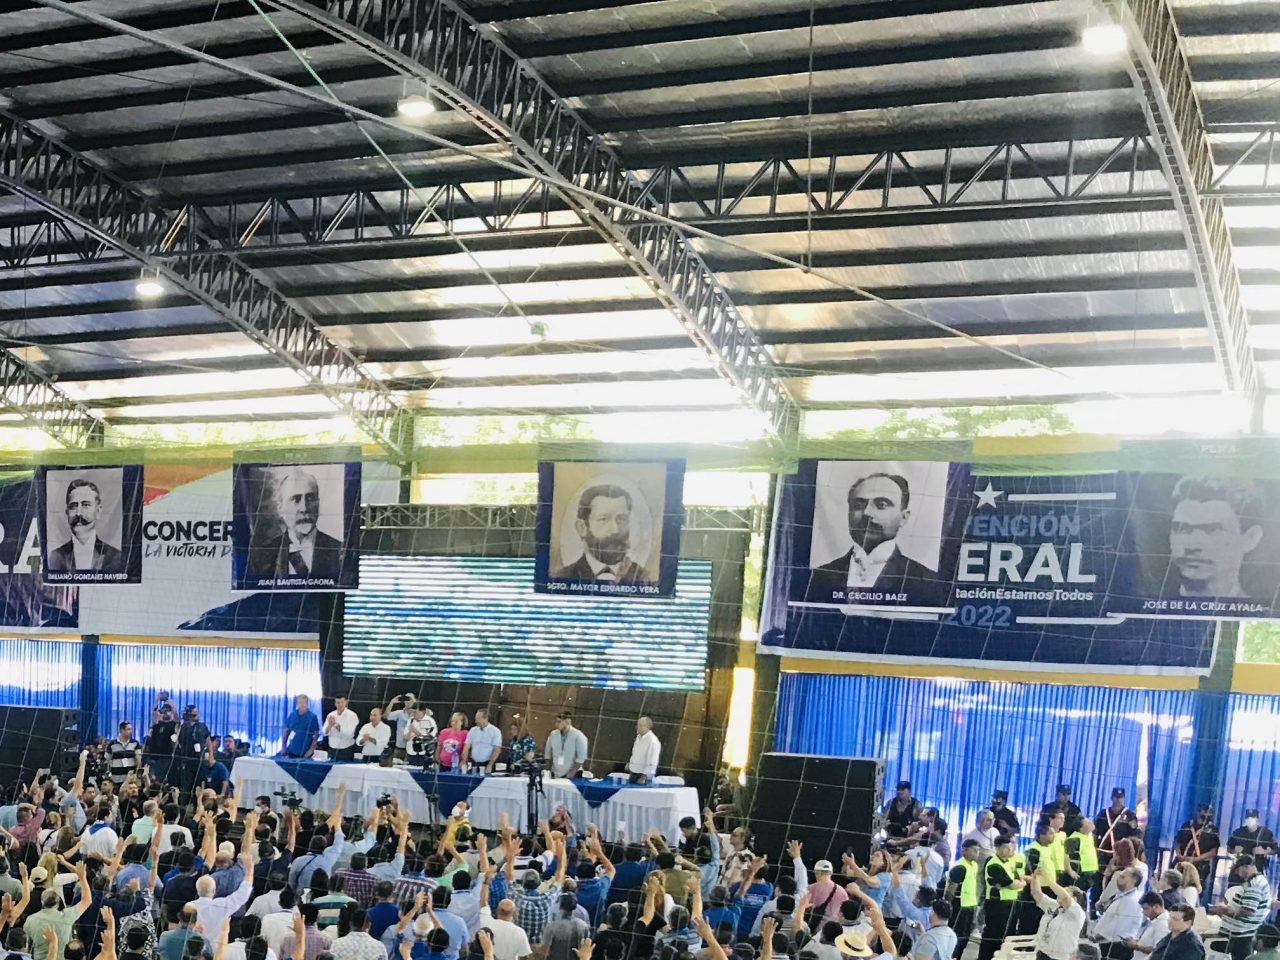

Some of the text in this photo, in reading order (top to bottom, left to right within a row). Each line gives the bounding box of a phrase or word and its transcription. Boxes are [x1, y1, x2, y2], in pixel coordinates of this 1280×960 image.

[145, 544, 162, 558] LA
[166, 543, 216, 558] VICTORIA
[957, 542, 1097, 583] ERAL
[307, 578, 335, 586] GAONA
[570, 583, 599, 592] MAYOR
[600, 584, 638, 593] EDUARDO
[638, 585, 660, 594] VERA
[832, 591, 908, 601] DR. CECILIO BAEZ
[1142, 600, 1263, 612] JOSE DE LA CRUZ AYALA
